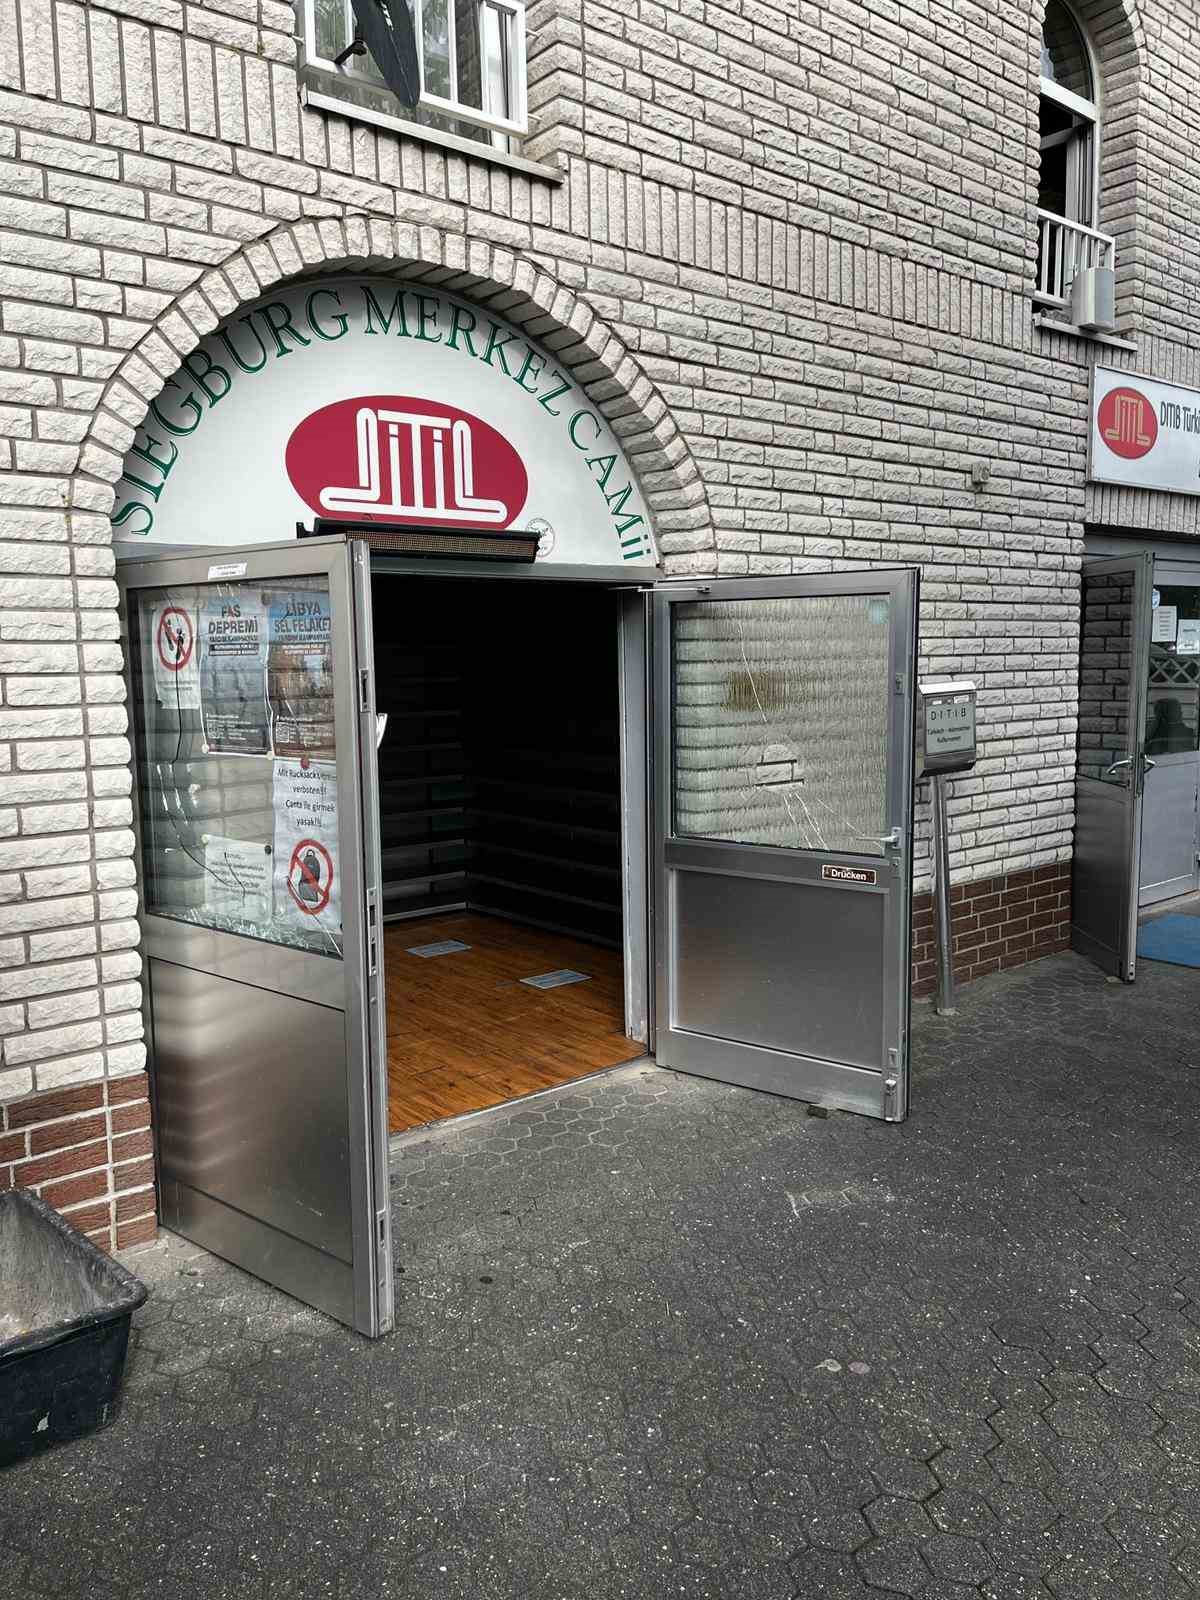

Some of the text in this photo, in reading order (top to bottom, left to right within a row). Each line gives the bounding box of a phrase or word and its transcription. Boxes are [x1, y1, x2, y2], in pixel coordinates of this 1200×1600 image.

[111, 288, 350, 537] SIEGBURG
[360, 285, 574, 417] MERKEZ
[221, 604, 241, 617] FAS
[831, 868, 867, 881] Drücken
